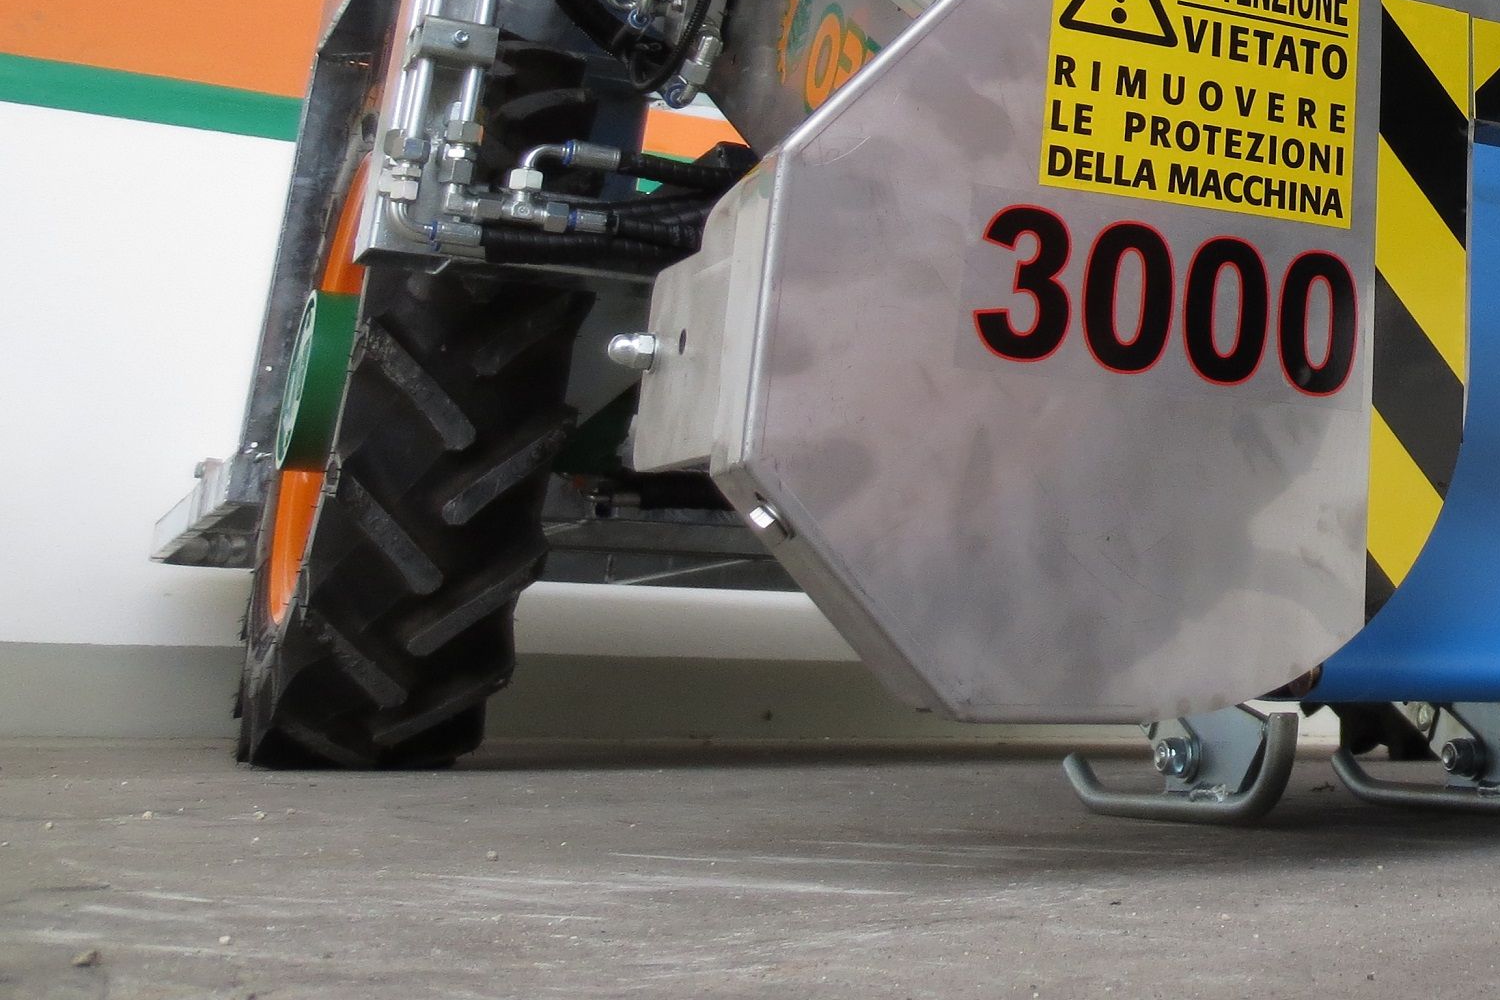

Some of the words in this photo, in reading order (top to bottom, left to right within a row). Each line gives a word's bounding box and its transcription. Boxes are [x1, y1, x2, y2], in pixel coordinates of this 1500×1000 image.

[1182, 15, 1349, 80] VIETATO
[1054, 54, 1346, 134] RIMUOVERE
[1050, 99, 1094, 136] LE
[1124, 111, 1345, 176] PROTEZIONI
[1047, 144, 1157, 191] DELLA
[1167, 163, 1344, 219] MACCHINA
[973, 204, 1358, 397] 3000
